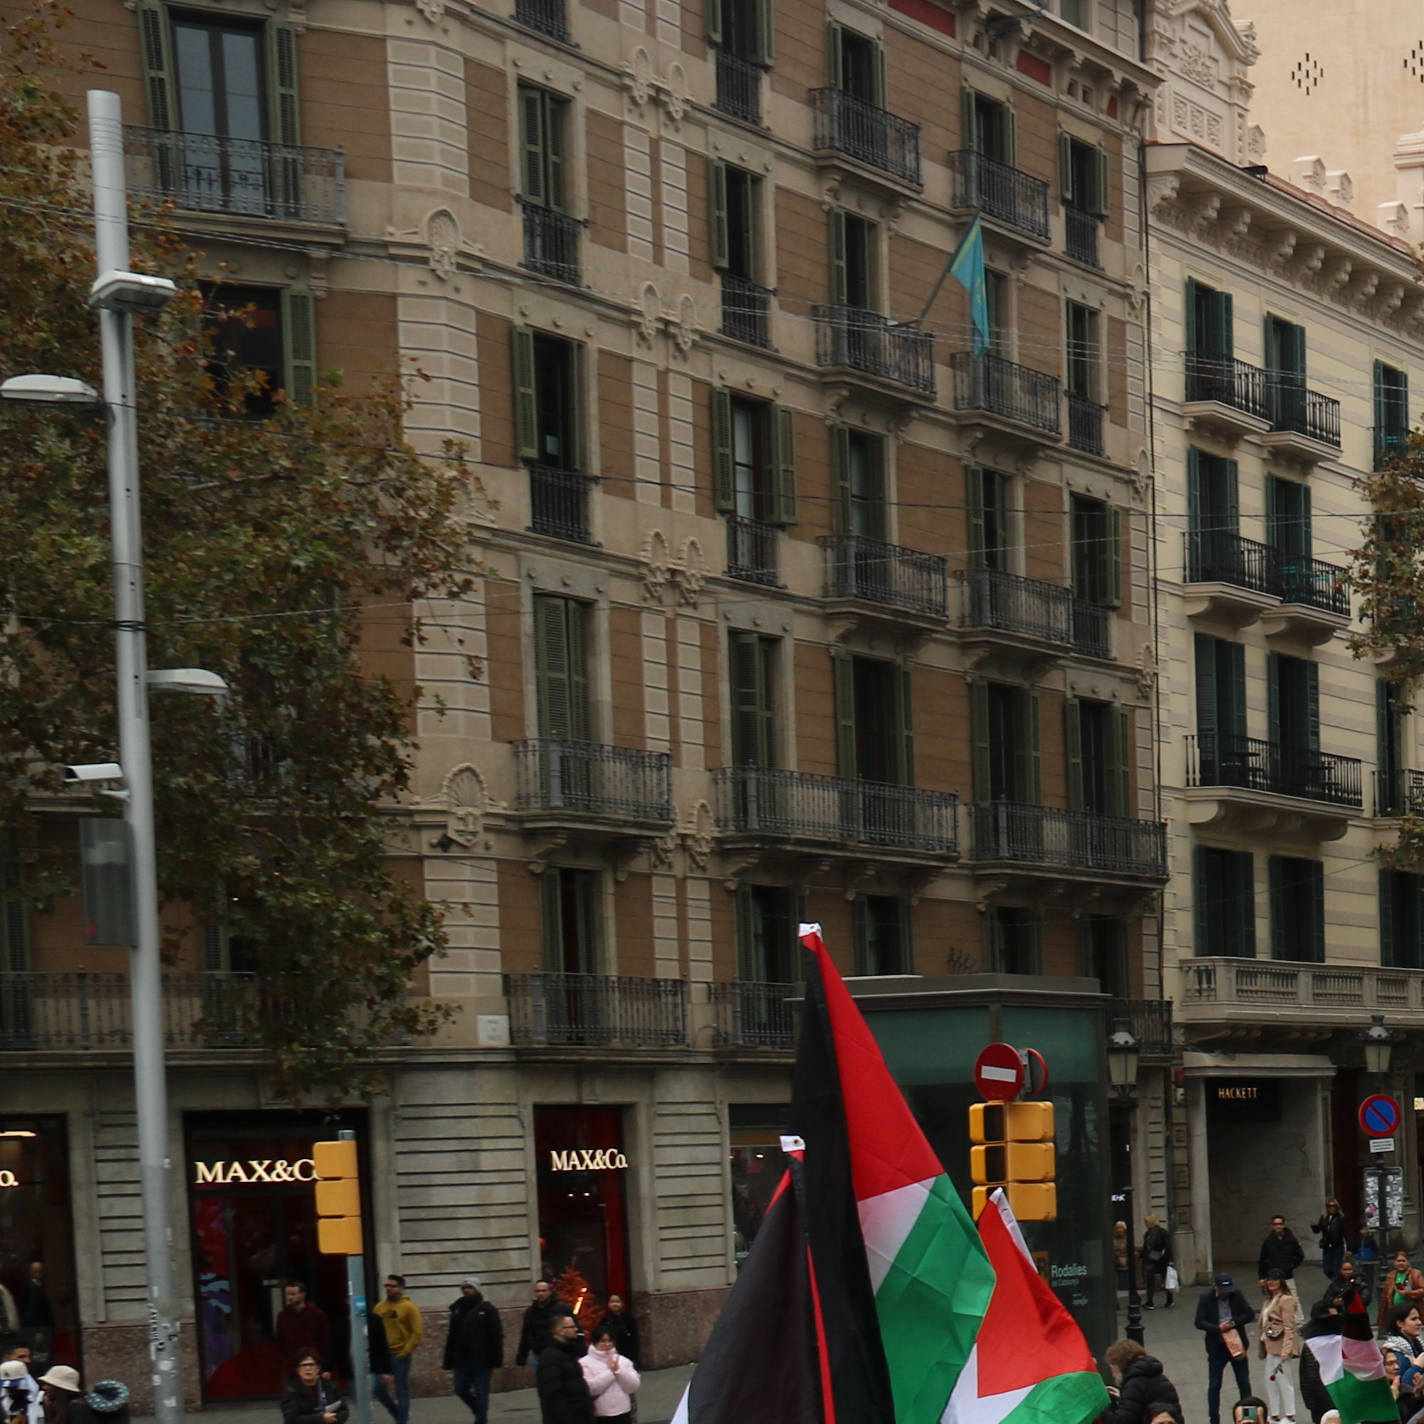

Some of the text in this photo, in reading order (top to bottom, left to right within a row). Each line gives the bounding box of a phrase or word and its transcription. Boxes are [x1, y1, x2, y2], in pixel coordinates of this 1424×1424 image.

[1218, 1087, 1258, 1099] HACKETT
[194, 1158, 316, 1184] MAX&C
[550, 1148, 628, 1171] MAX&Co.
